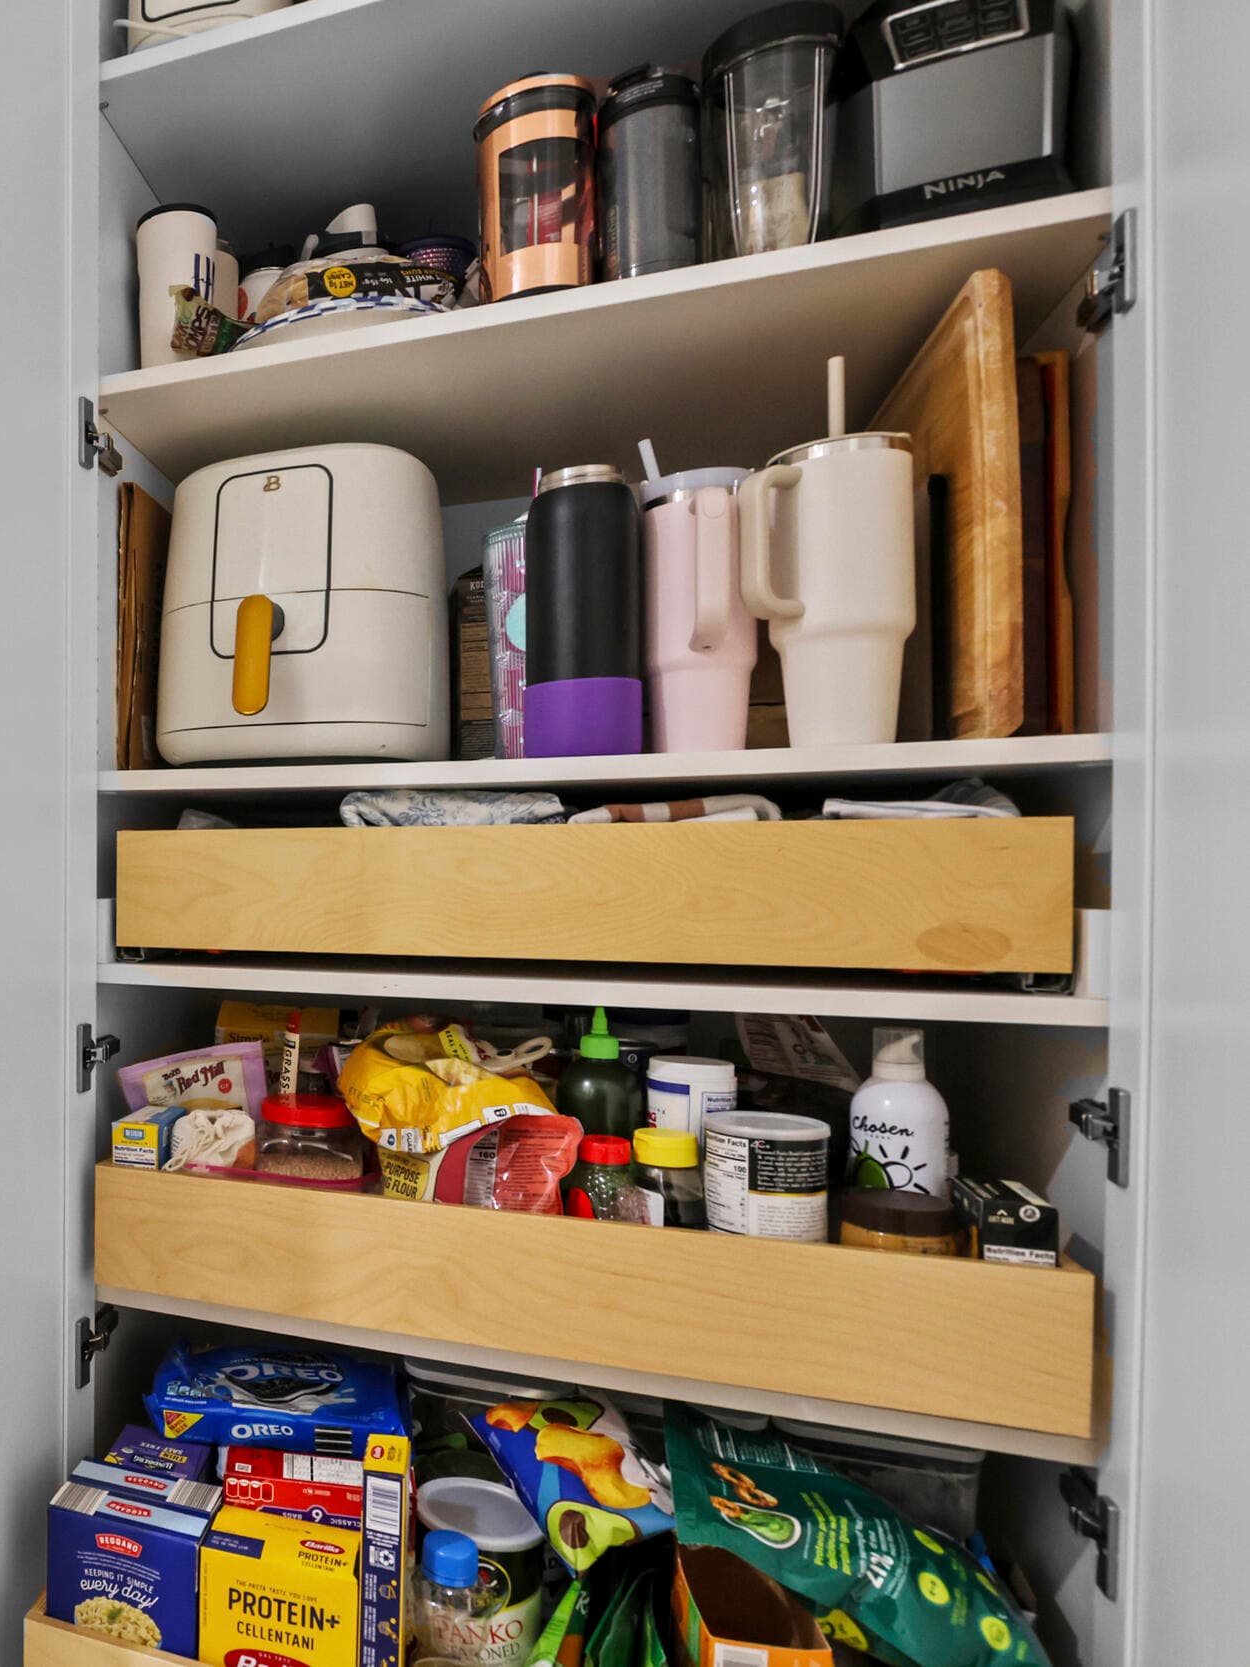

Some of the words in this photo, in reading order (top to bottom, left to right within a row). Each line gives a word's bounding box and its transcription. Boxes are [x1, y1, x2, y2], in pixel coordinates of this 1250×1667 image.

[923, 170, 1006, 200] NINJA
[176, 1070, 200, 1096] Red
[199, 1060, 226, 1087] Mill
[852, 1115, 915, 1137] Chosen
[726, 1138, 747, 1148] Facts
[478, 1151, 496, 1159] 160
[393, 1180, 418, 1199] FLOUR
[986, 1247, 1026, 1256] Nutrition
[220, 1363, 344, 1382] OREO
[230, 1423, 295, 1439] OREO
[99, 1536, 139, 1553] REGGANO
[304, 1541, 340, 1553] Barilla
[84, 1568, 115, 1581] KEEPING
[116, 1573, 125, 1582] IT
[126, 1576, 155, 1594] SIMPLE
[236, 1579, 246, 1587] THE
[248, 1581, 267, 1592] PASTA
[268, 1586, 287, 1596] TASTE
[79, 1579, 120, 1599] every
[121, 1584, 159, 1609] day!
[236, 1620, 315, 1651] CELLENTANI
